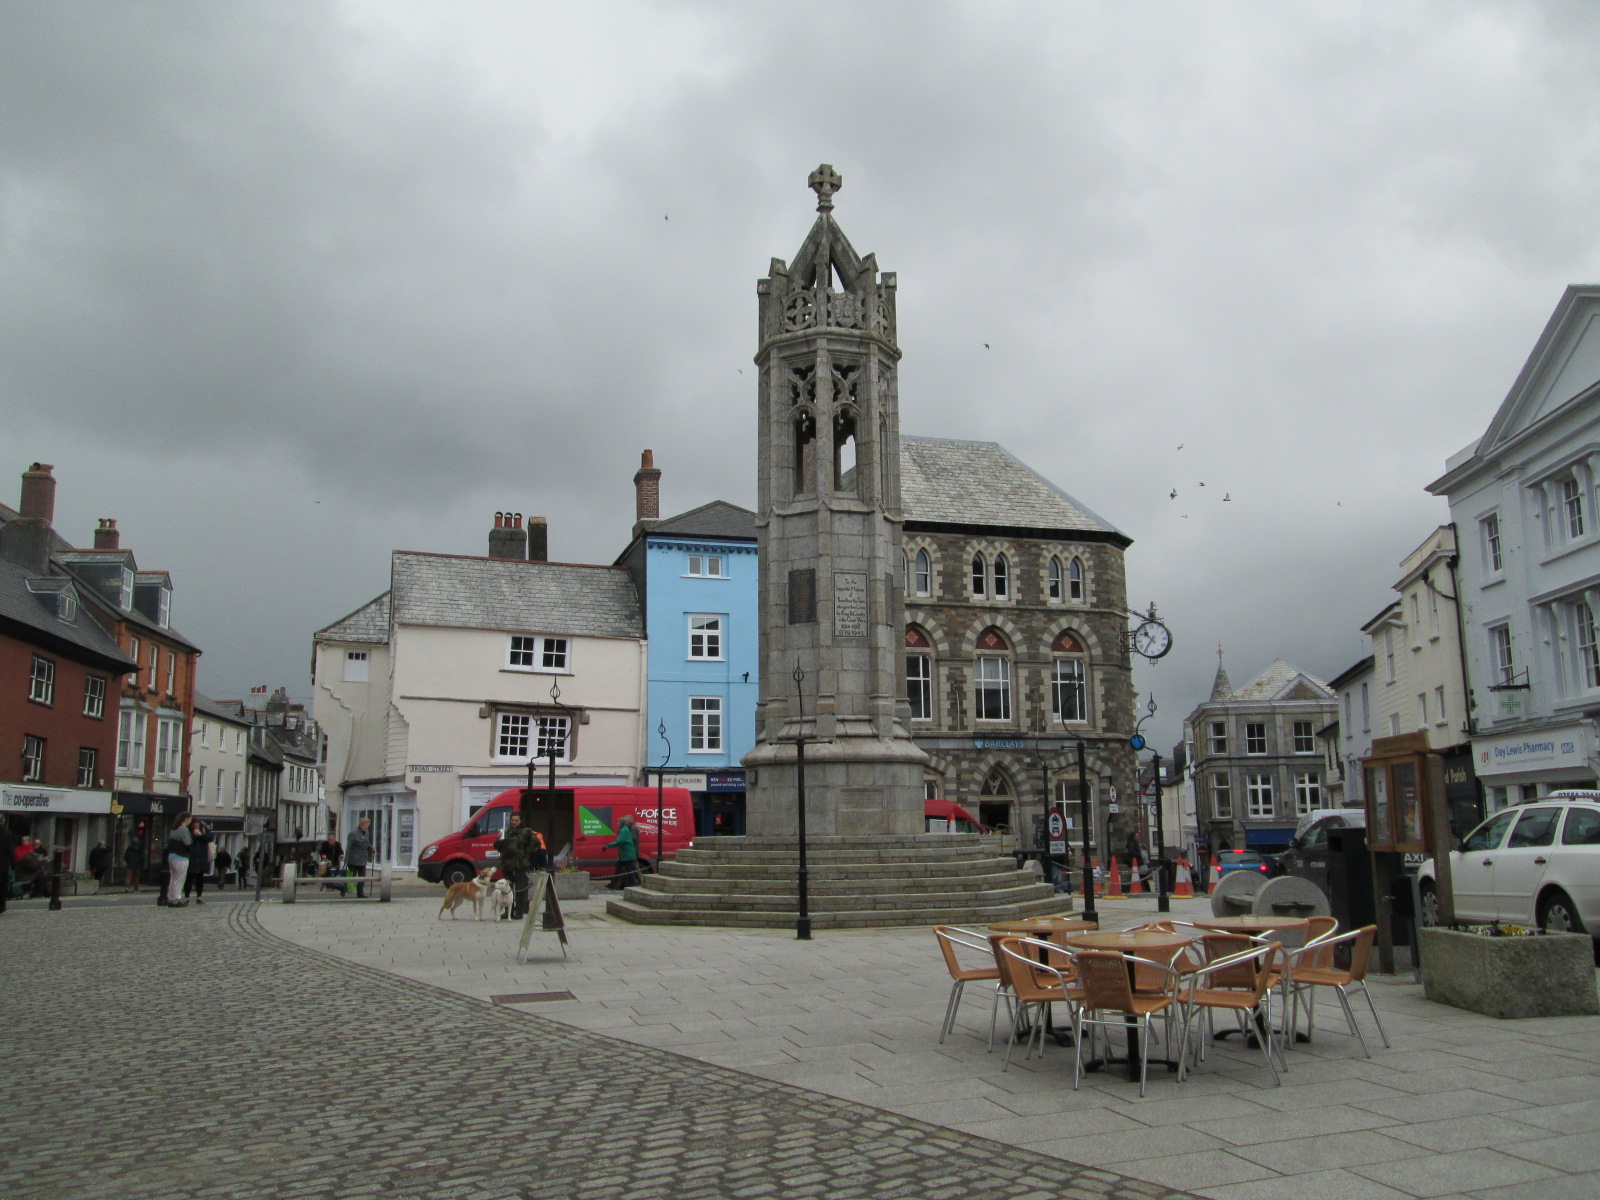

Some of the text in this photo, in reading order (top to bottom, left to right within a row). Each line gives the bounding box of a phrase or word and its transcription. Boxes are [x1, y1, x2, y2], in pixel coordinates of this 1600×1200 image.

[985, 740, 1024, 748] BARCLAYS
[1494, 746, 1506, 758] Day
[1506, 744, 1523, 756] Lewis
[1523, 741, 1554, 754] Pharmacy
[3, 791, 49, 808] The co-operative
[1404, 853, 1423, 862] AXI
